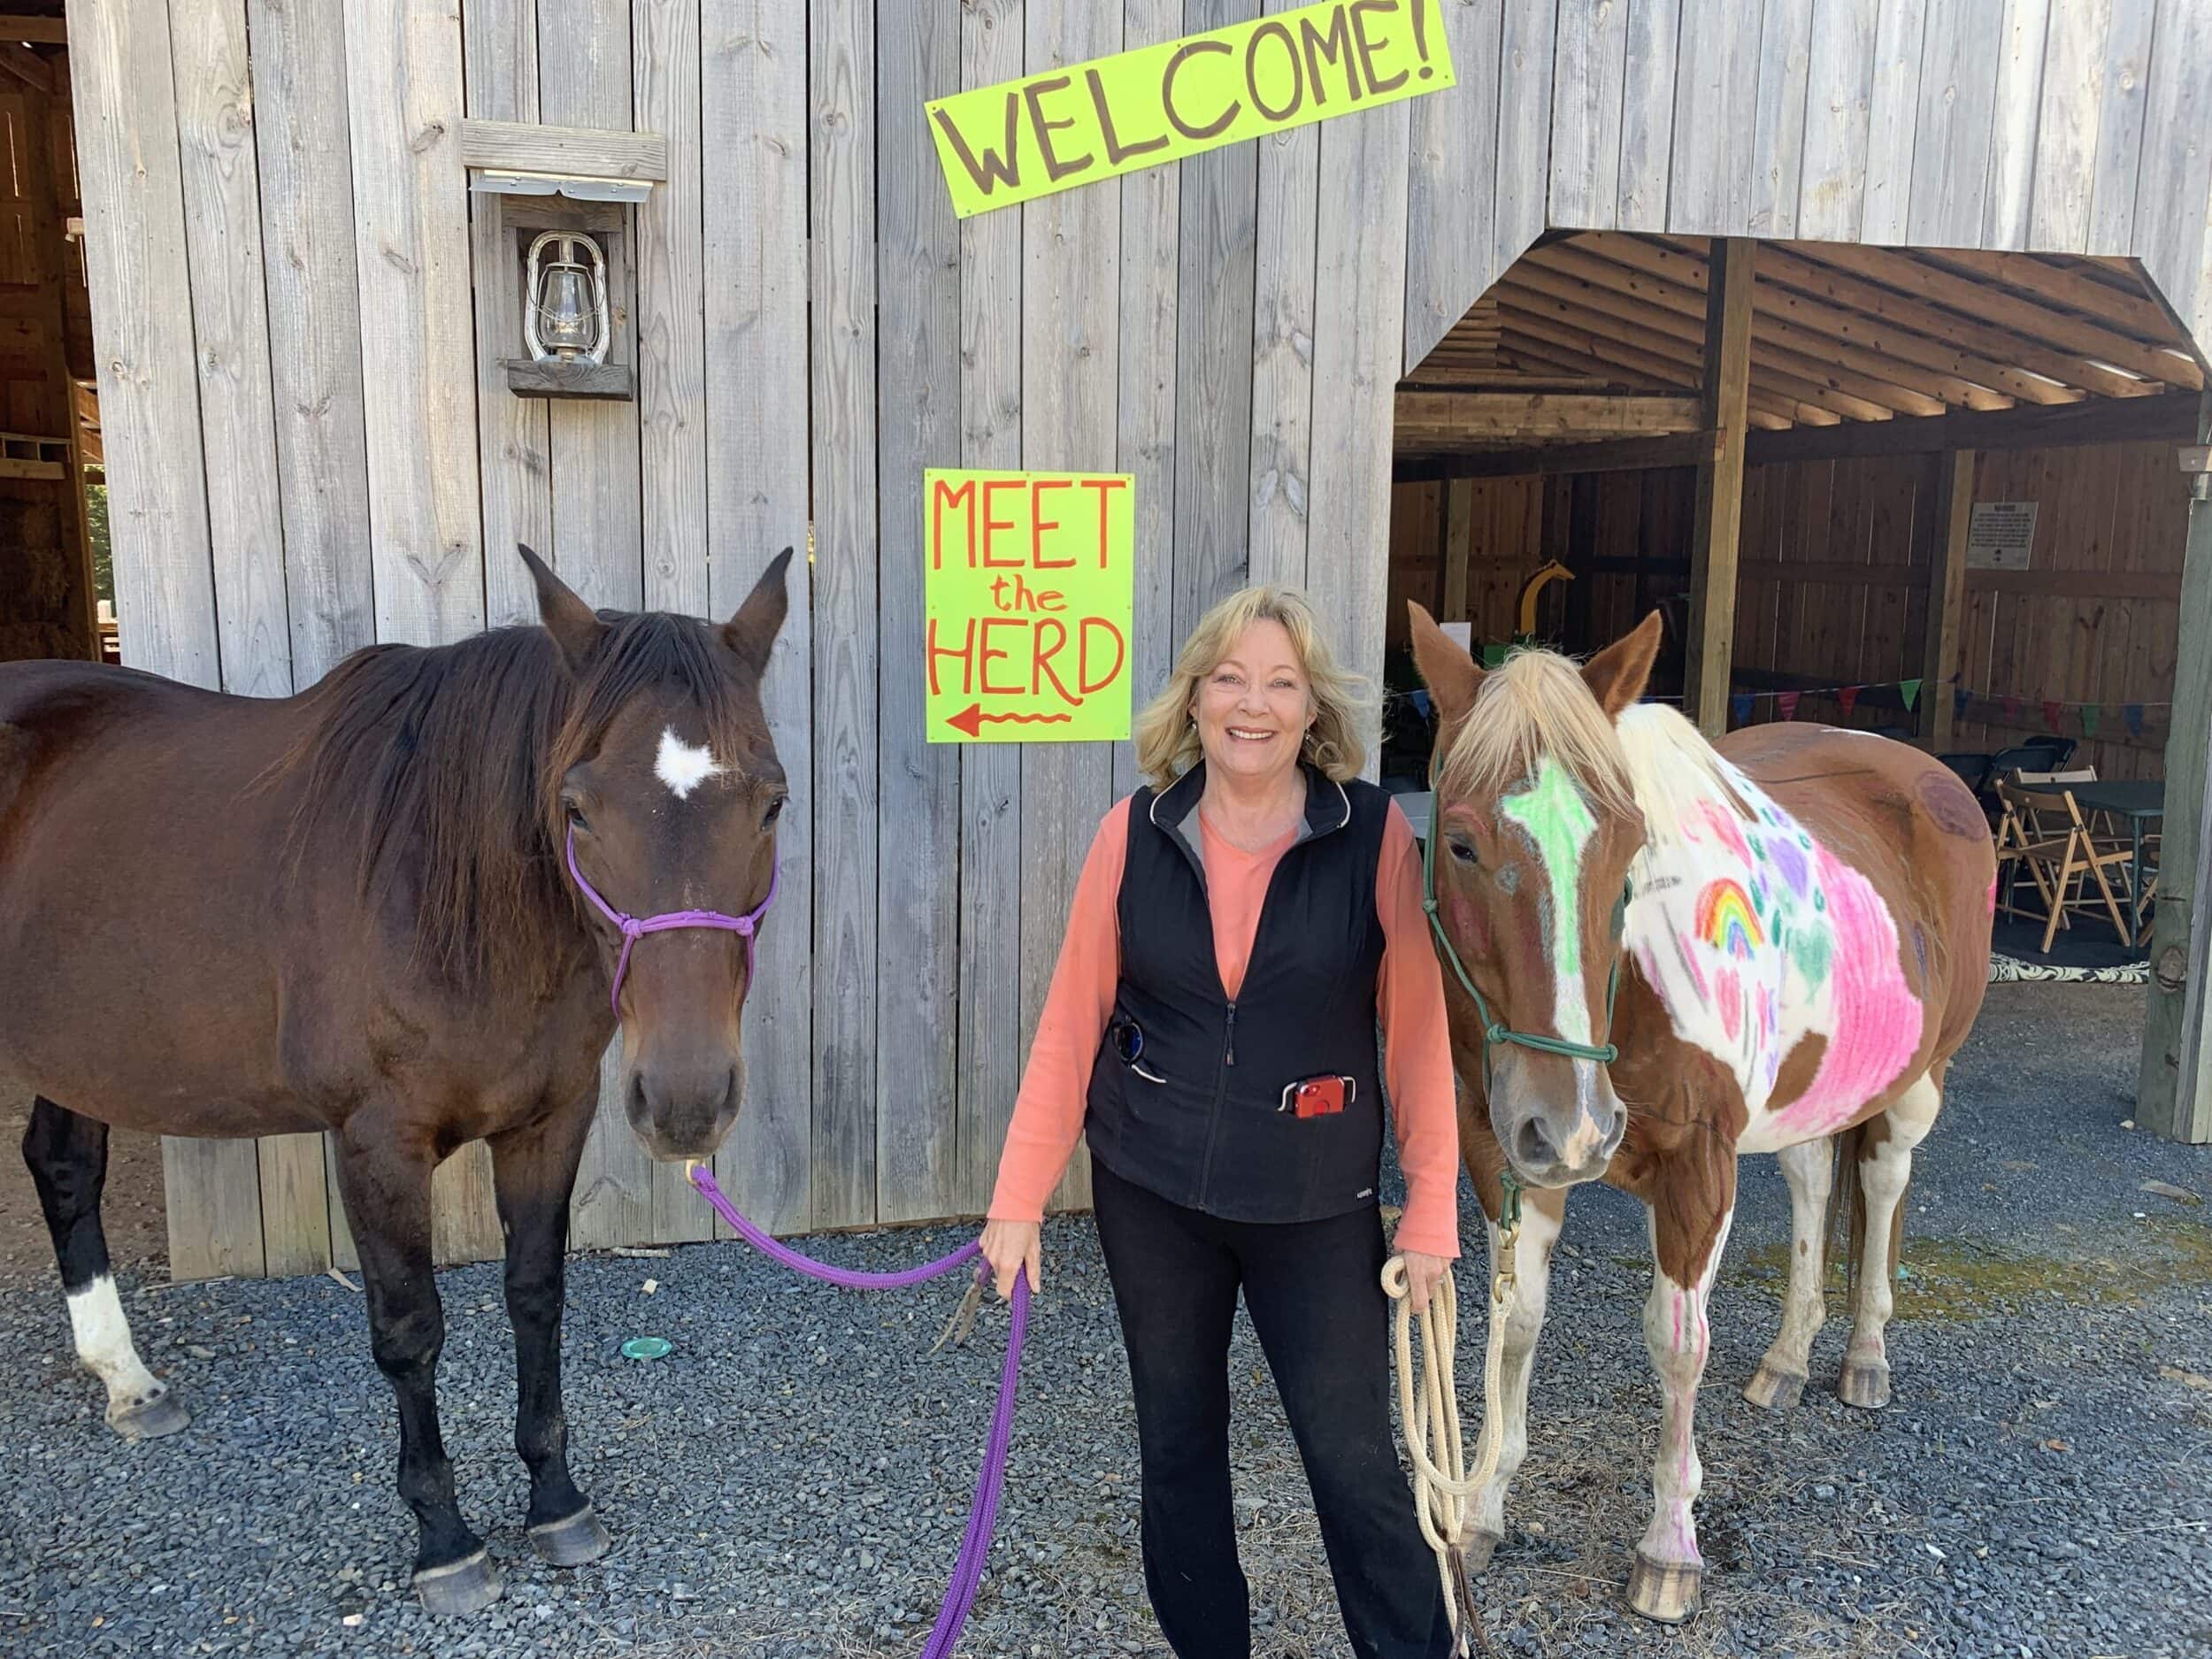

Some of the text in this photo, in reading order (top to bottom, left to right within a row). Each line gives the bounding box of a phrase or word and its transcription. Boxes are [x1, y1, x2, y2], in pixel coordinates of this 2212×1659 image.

[934, 0, 1434, 196] WELCOME!
[933, 479, 1127, 570] MEET
[988, 572, 1069, 613] the
[927, 616, 1125, 708] HERD
